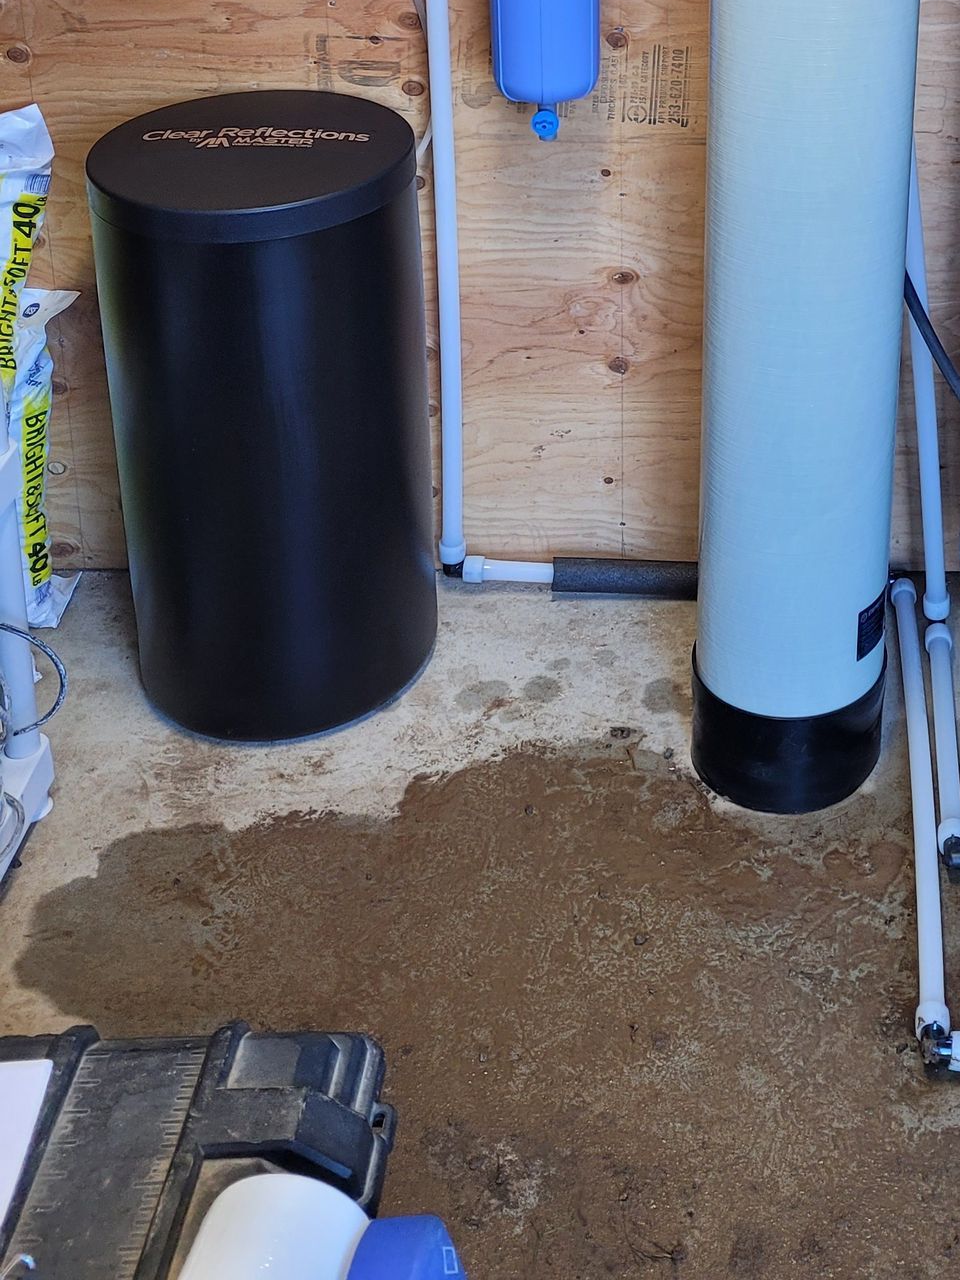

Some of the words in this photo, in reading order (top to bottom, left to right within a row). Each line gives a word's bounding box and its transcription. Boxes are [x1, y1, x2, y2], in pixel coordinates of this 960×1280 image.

[667, 48, 684, 124] 253-620-7400
[142, 128, 213, 142] Clear
[217, 126, 371, 143] Reflections
[232, 137, 315, 145] MASTER
[12, 201, 41, 239] 40
[27, 541, 48, 574] 40
[32, 573, 43, 587] LB
